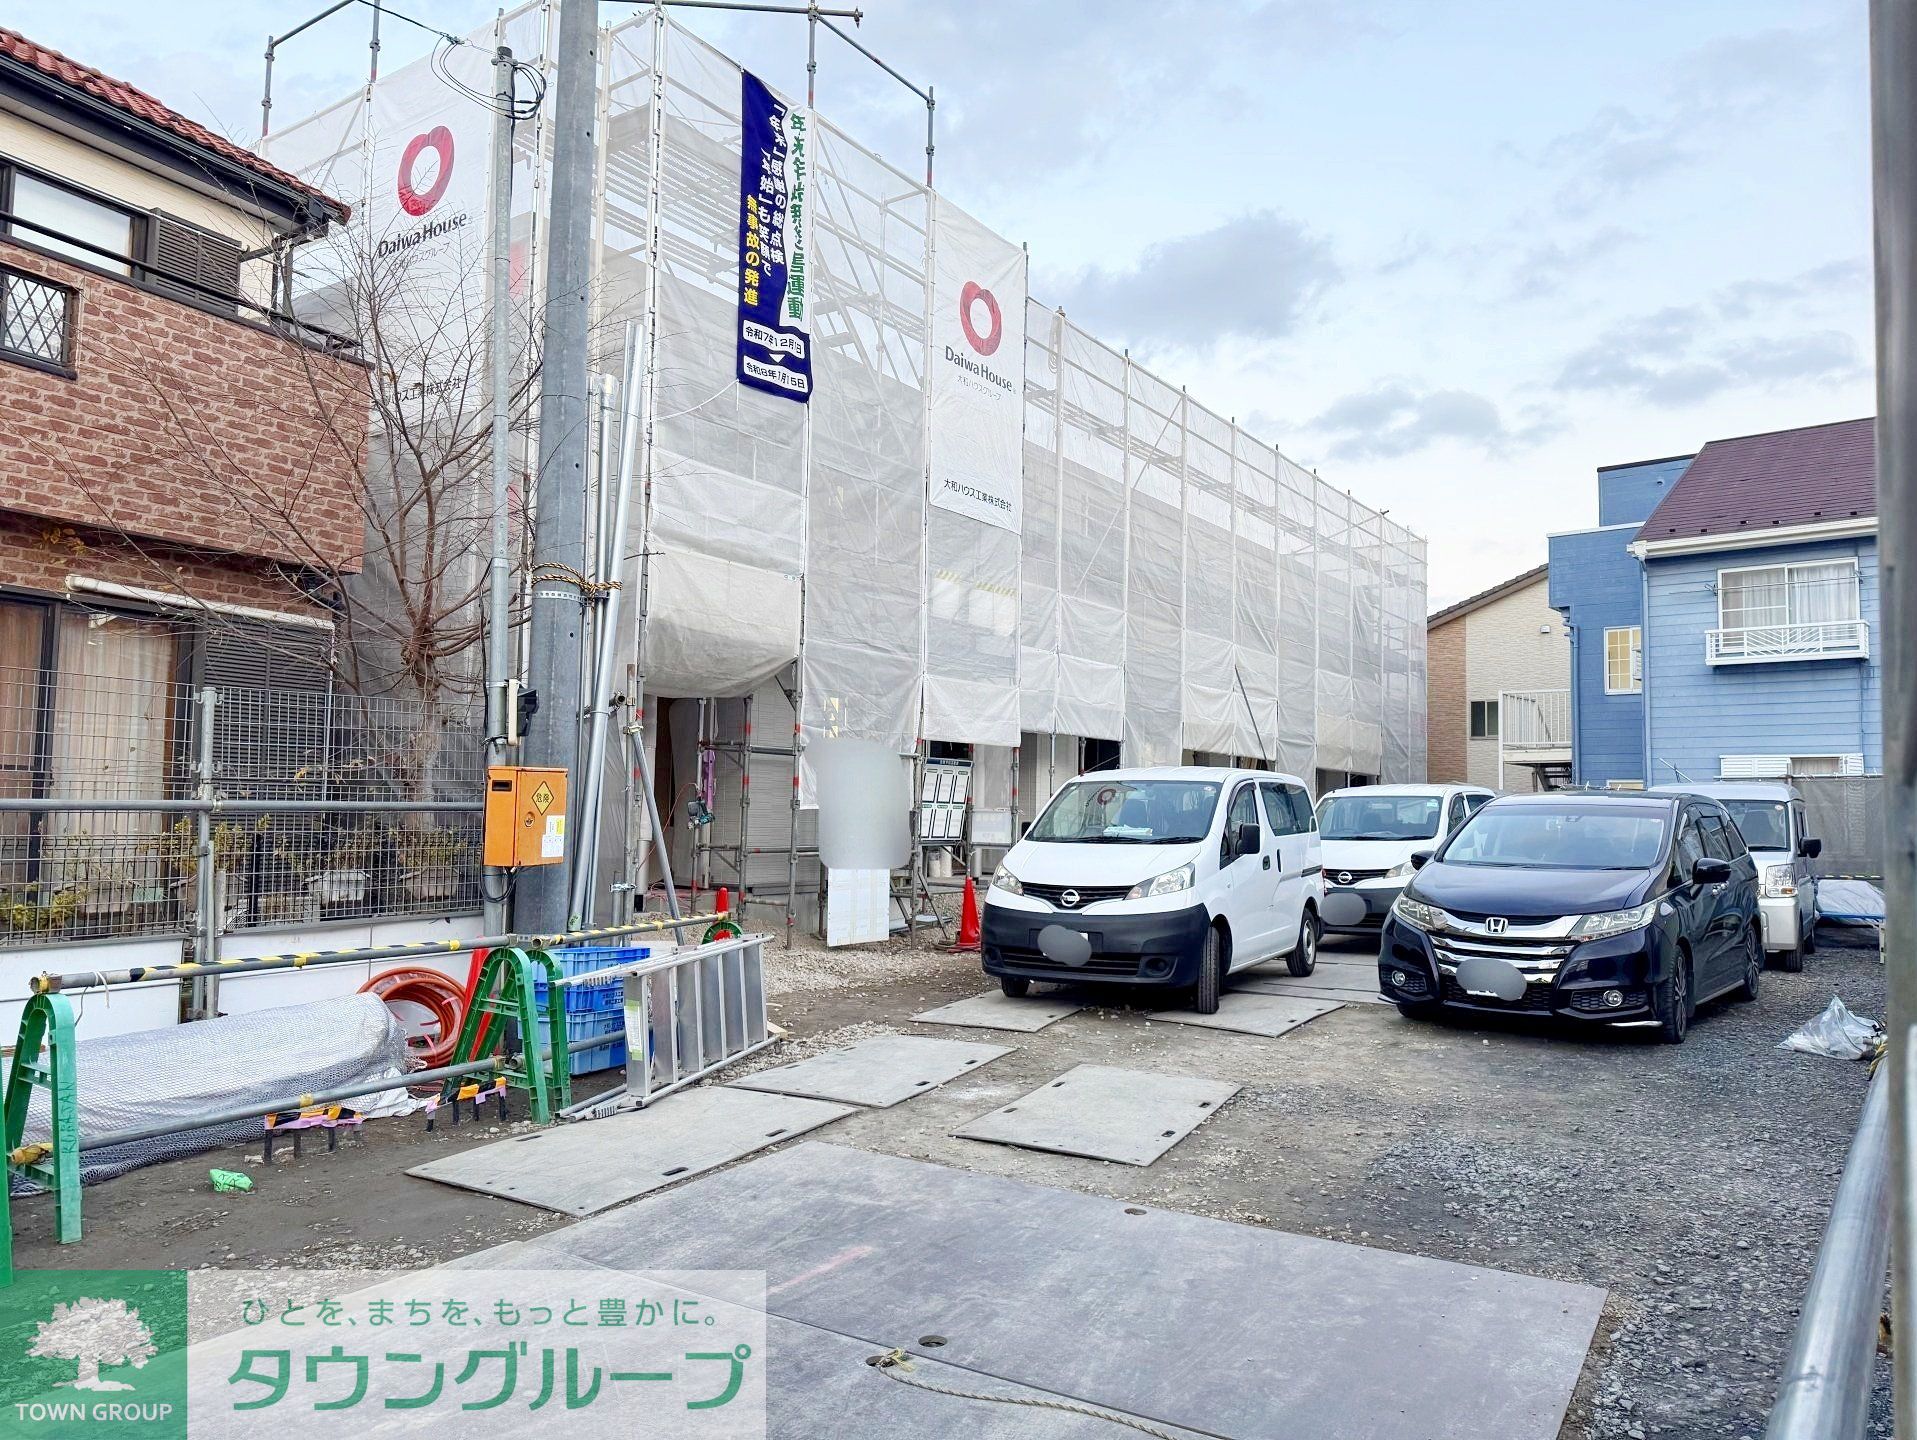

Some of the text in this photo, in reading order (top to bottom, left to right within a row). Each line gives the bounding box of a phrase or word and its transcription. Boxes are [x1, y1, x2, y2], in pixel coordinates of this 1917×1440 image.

[743, 193, 760, 306] 無事故の発進
[746, 362, 805, 389] 令和8年1月15日
[957, 375, 1002, 401] 大和ハウスグループ
[944, 478, 1012, 512] 大和ハウス工業株式会社
[536, 792, 550, 804] 危険
